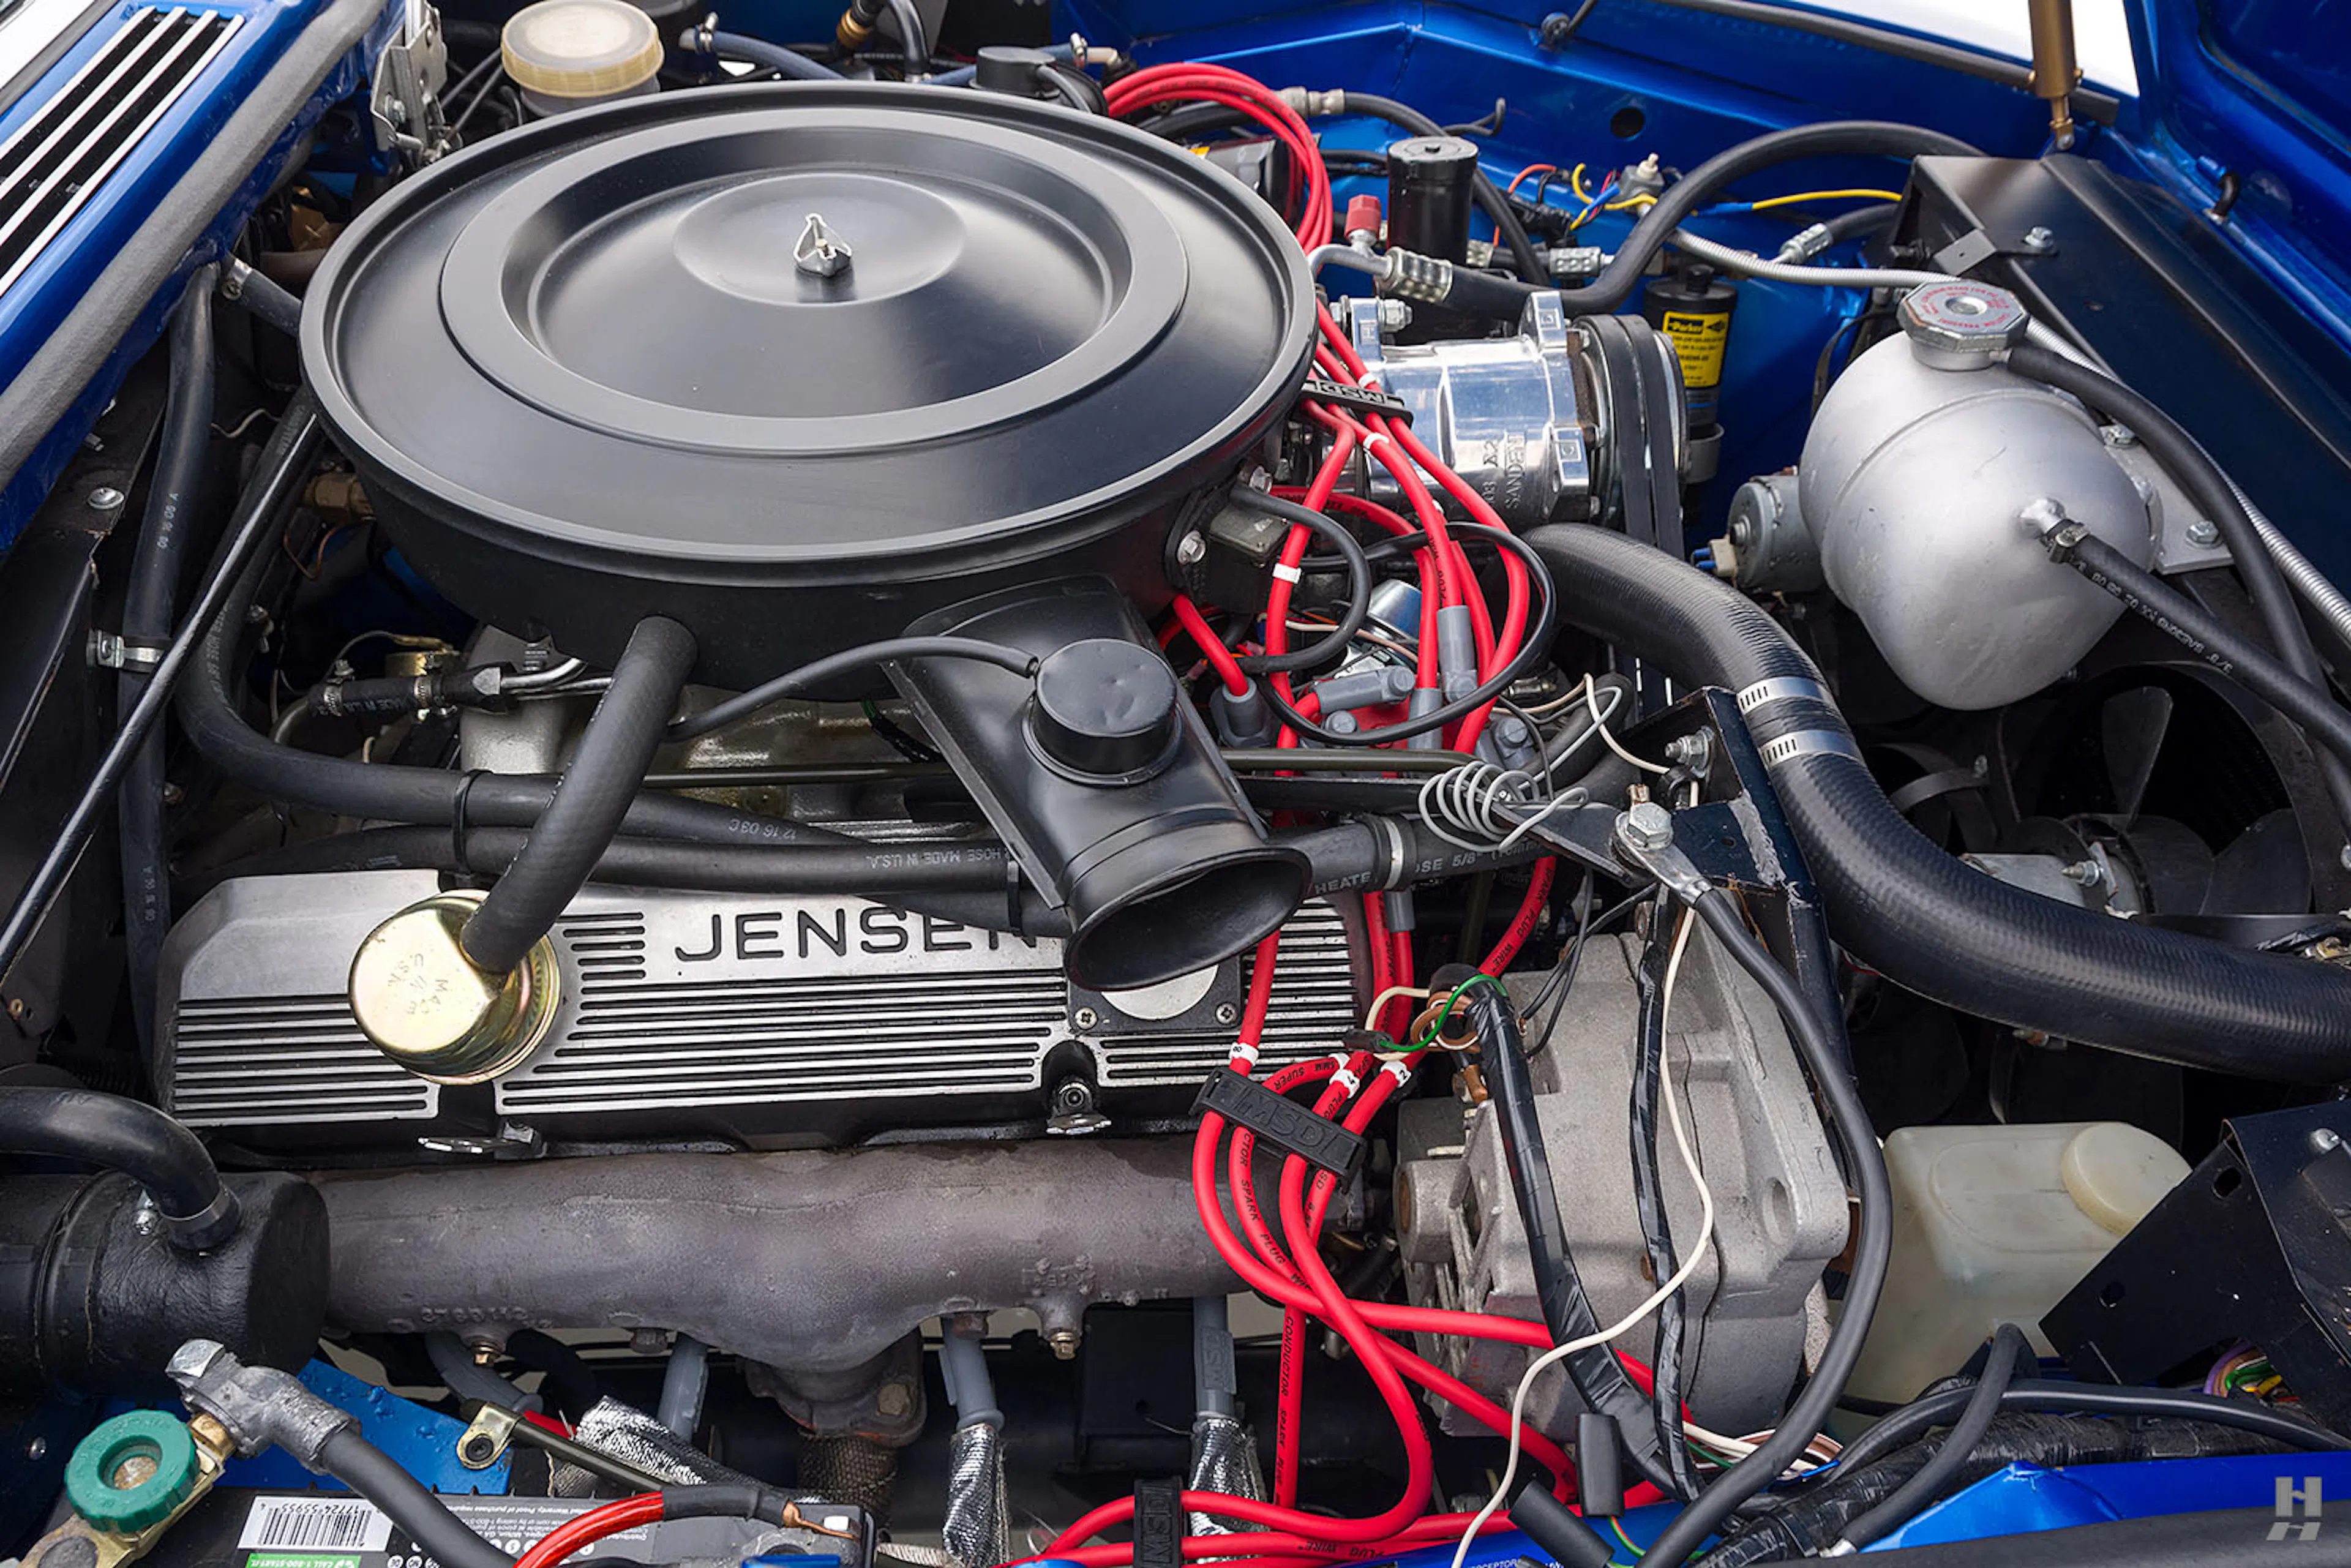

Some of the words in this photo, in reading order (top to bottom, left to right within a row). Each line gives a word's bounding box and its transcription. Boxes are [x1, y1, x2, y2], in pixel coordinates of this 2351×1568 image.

[1321, 383, 1384, 403] MSD
[924, 850, 962, 866] MADE
[967, 847, 1001, 863] HOSE
[1273, 1067, 1305, 1091] SUPER
[1237, 1096, 1325, 1147] MSD
[1240, 1179, 1261, 1222] SPARK
[1260, 1233, 1286, 1266] PLUG
[1280, 1316, 1295, 1398] CONDUCTOR
[1143, 1498, 1173, 1564] MSD
